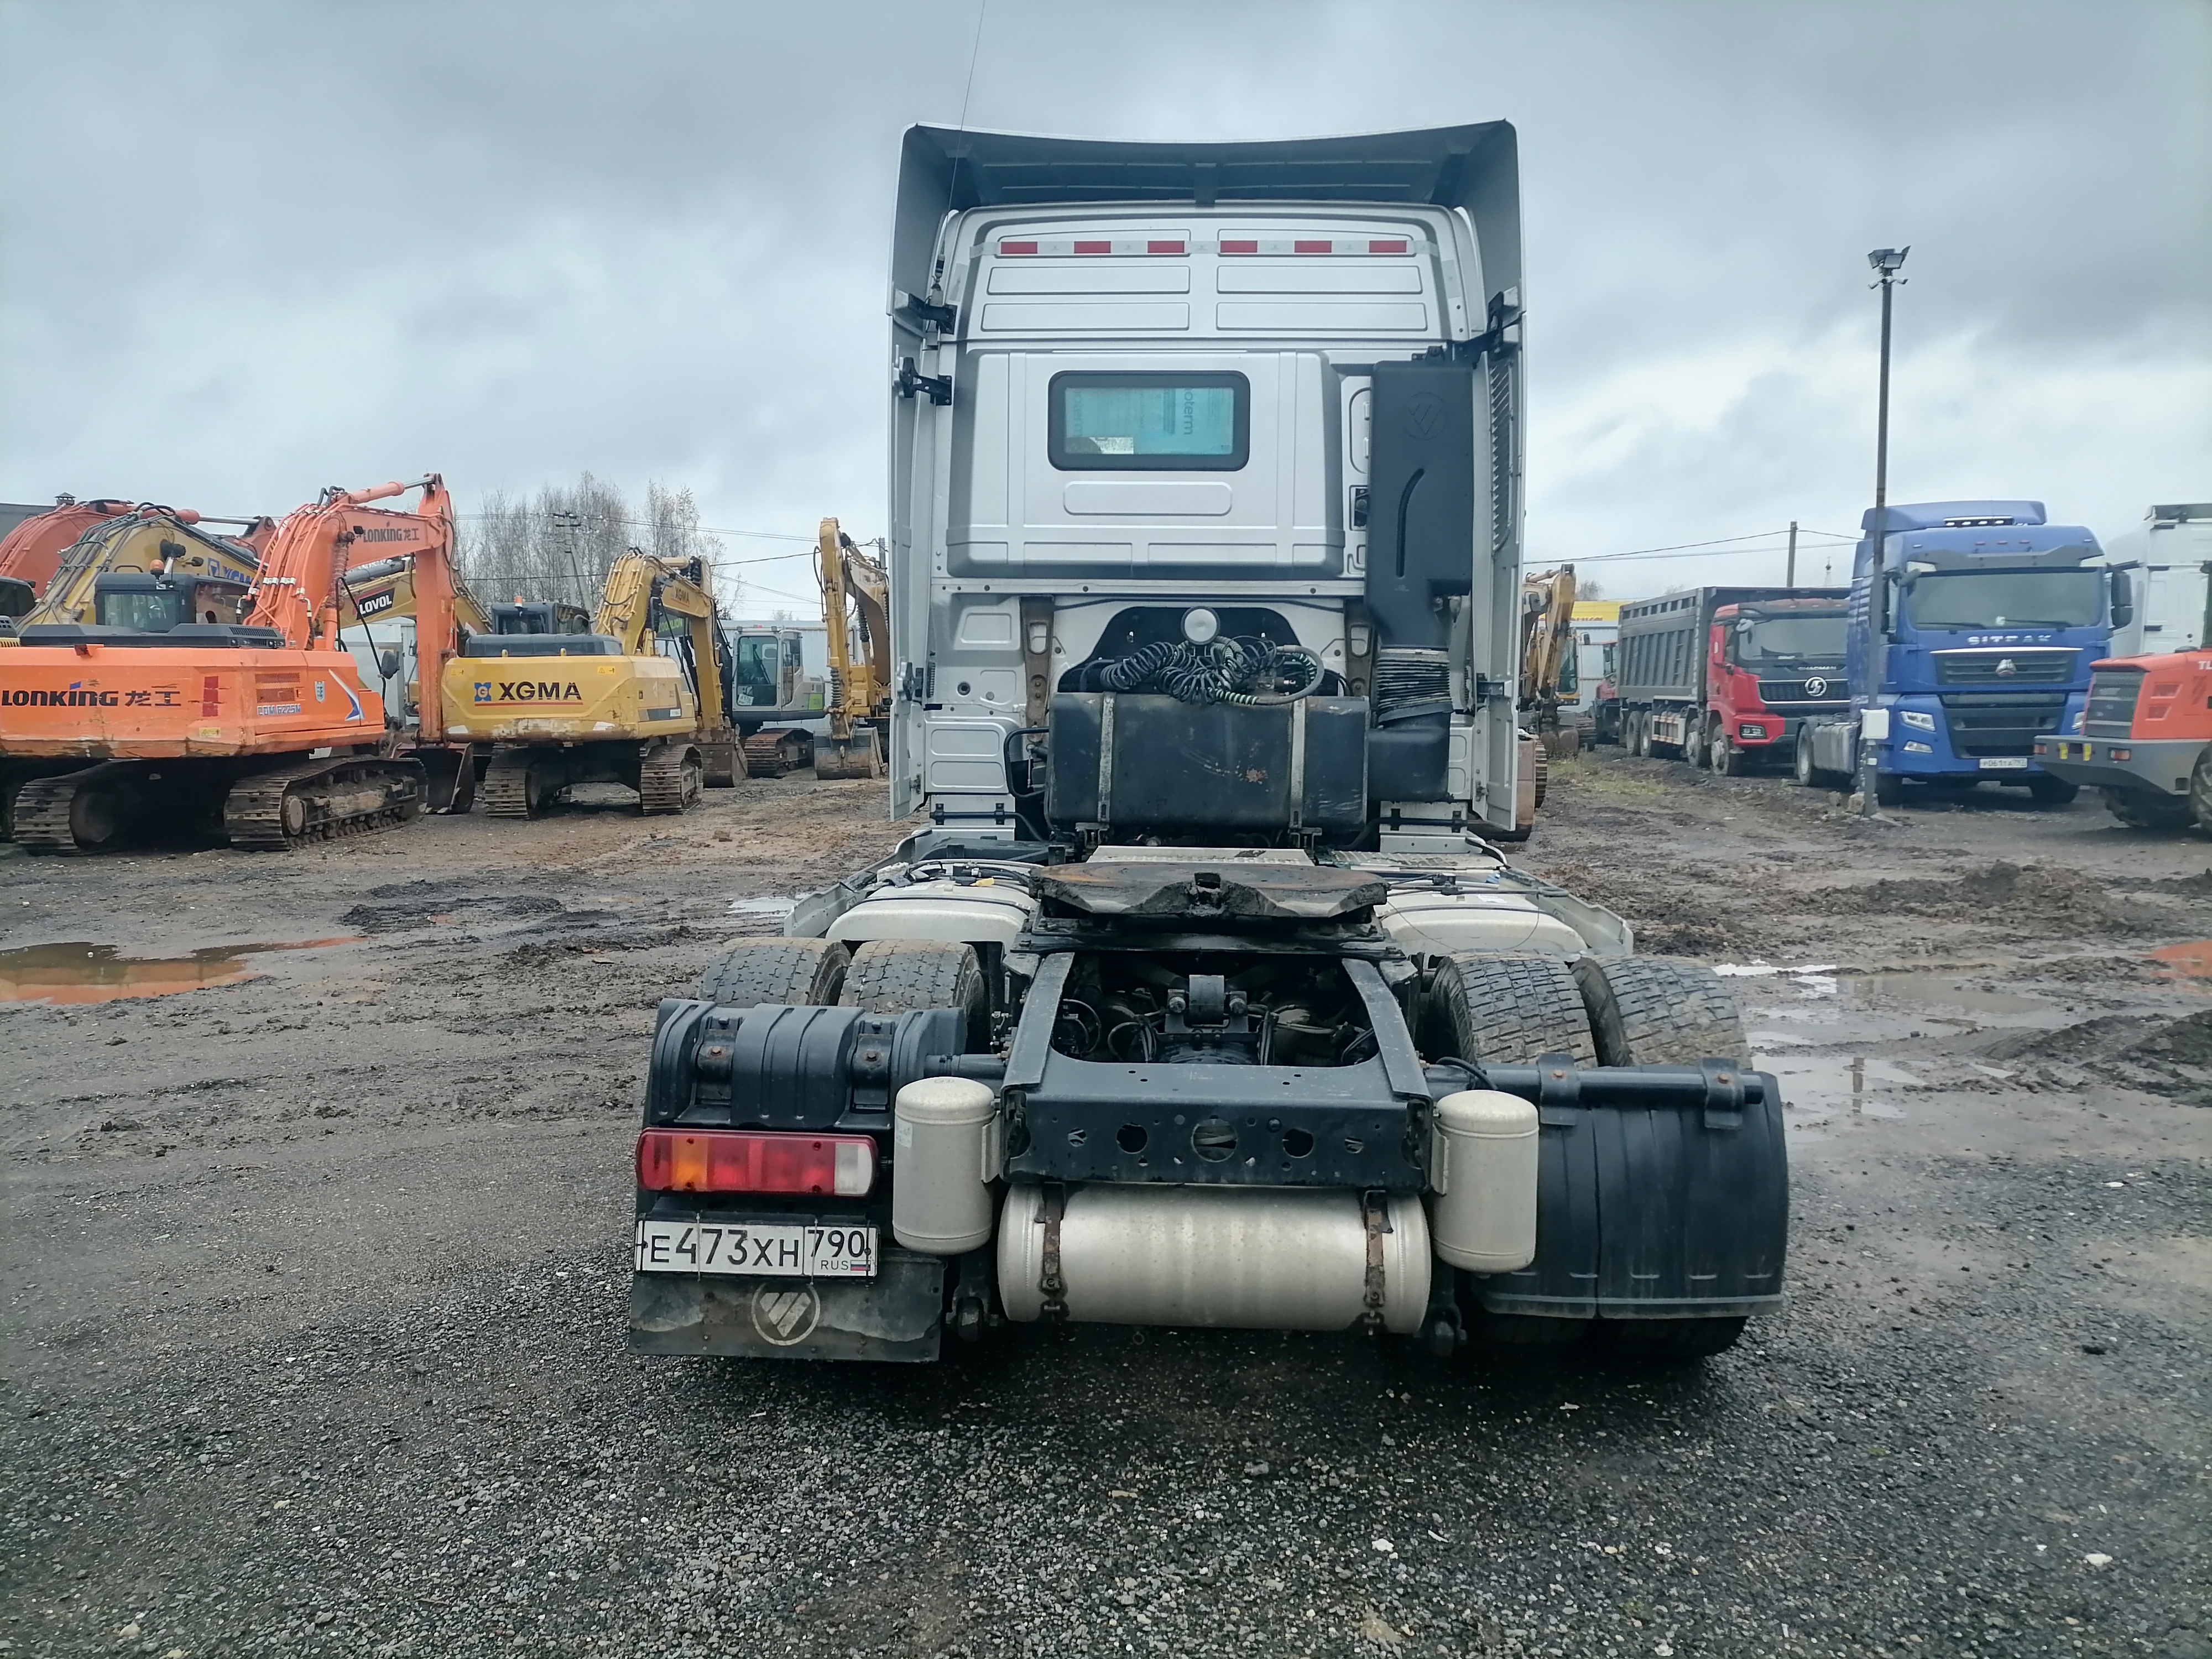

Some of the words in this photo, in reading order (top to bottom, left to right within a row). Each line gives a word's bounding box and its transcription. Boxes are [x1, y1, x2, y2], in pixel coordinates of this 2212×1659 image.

[359, 595, 392, 614] LOVOL
[675, 587, 690, 604] XGMA
[1, 681, 118, 706] LONKING
[125, 690, 181, 707] 龙工
[499, 681, 582, 701] XGMA
[807, 1229, 865, 1258] 790
[821, 1260, 849, 1271] RUS
